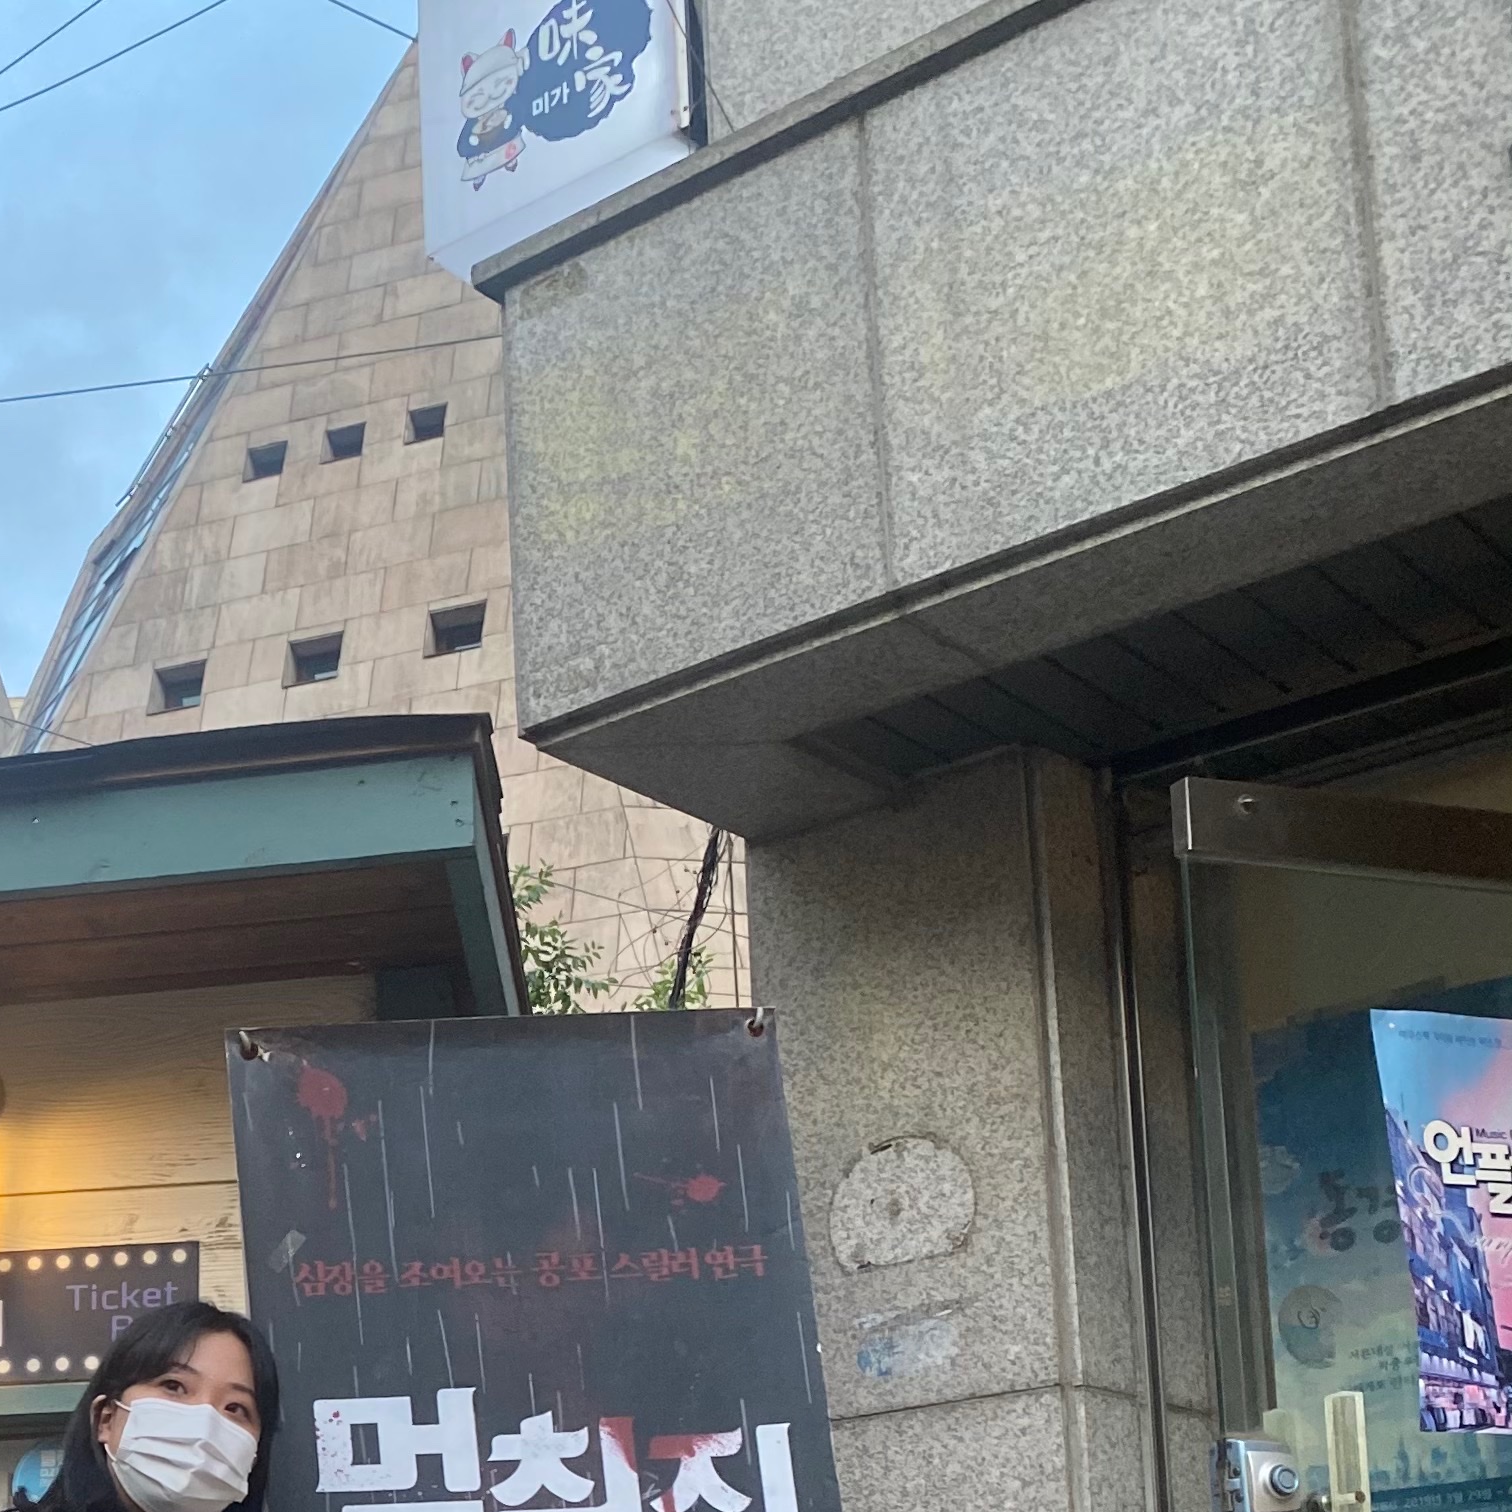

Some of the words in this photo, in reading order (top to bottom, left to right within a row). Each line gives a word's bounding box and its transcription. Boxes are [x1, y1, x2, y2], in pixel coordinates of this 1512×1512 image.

[531, 81, 571, 117] 미가
[1475, 1127, 1508, 1139] Music
[295, 1263, 389, 1297] 심장을
[398, 1257, 521, 1294] 조여오는
[530, 1248, 598, 1288] 공포
[609, 1247, 700, 1281] 스릴러
[703, 1243, 768, 1282] 연극
[65, 1281, 179, 1312] Ticket
